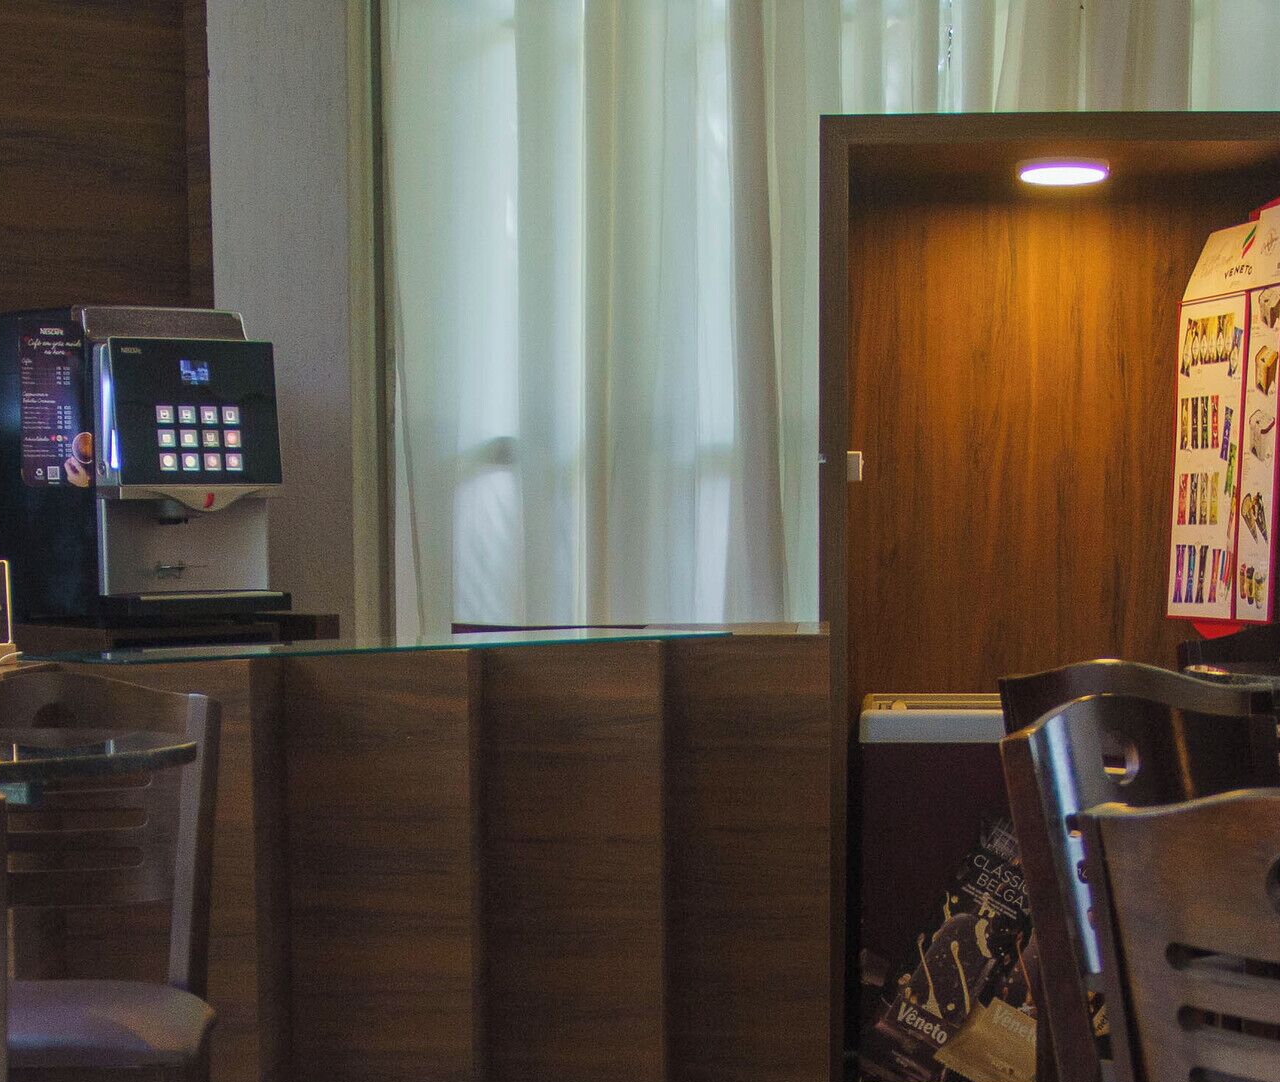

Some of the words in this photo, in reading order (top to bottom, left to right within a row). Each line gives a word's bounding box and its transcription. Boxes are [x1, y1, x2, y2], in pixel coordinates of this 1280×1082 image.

[1224, 264, 1253, 279] VENETO
[973, 852, 1029, 895] CLÁSSIC
[976, 871, 1025, 909] BELGA
[896, 1000, 949, 1045] Vêneto
